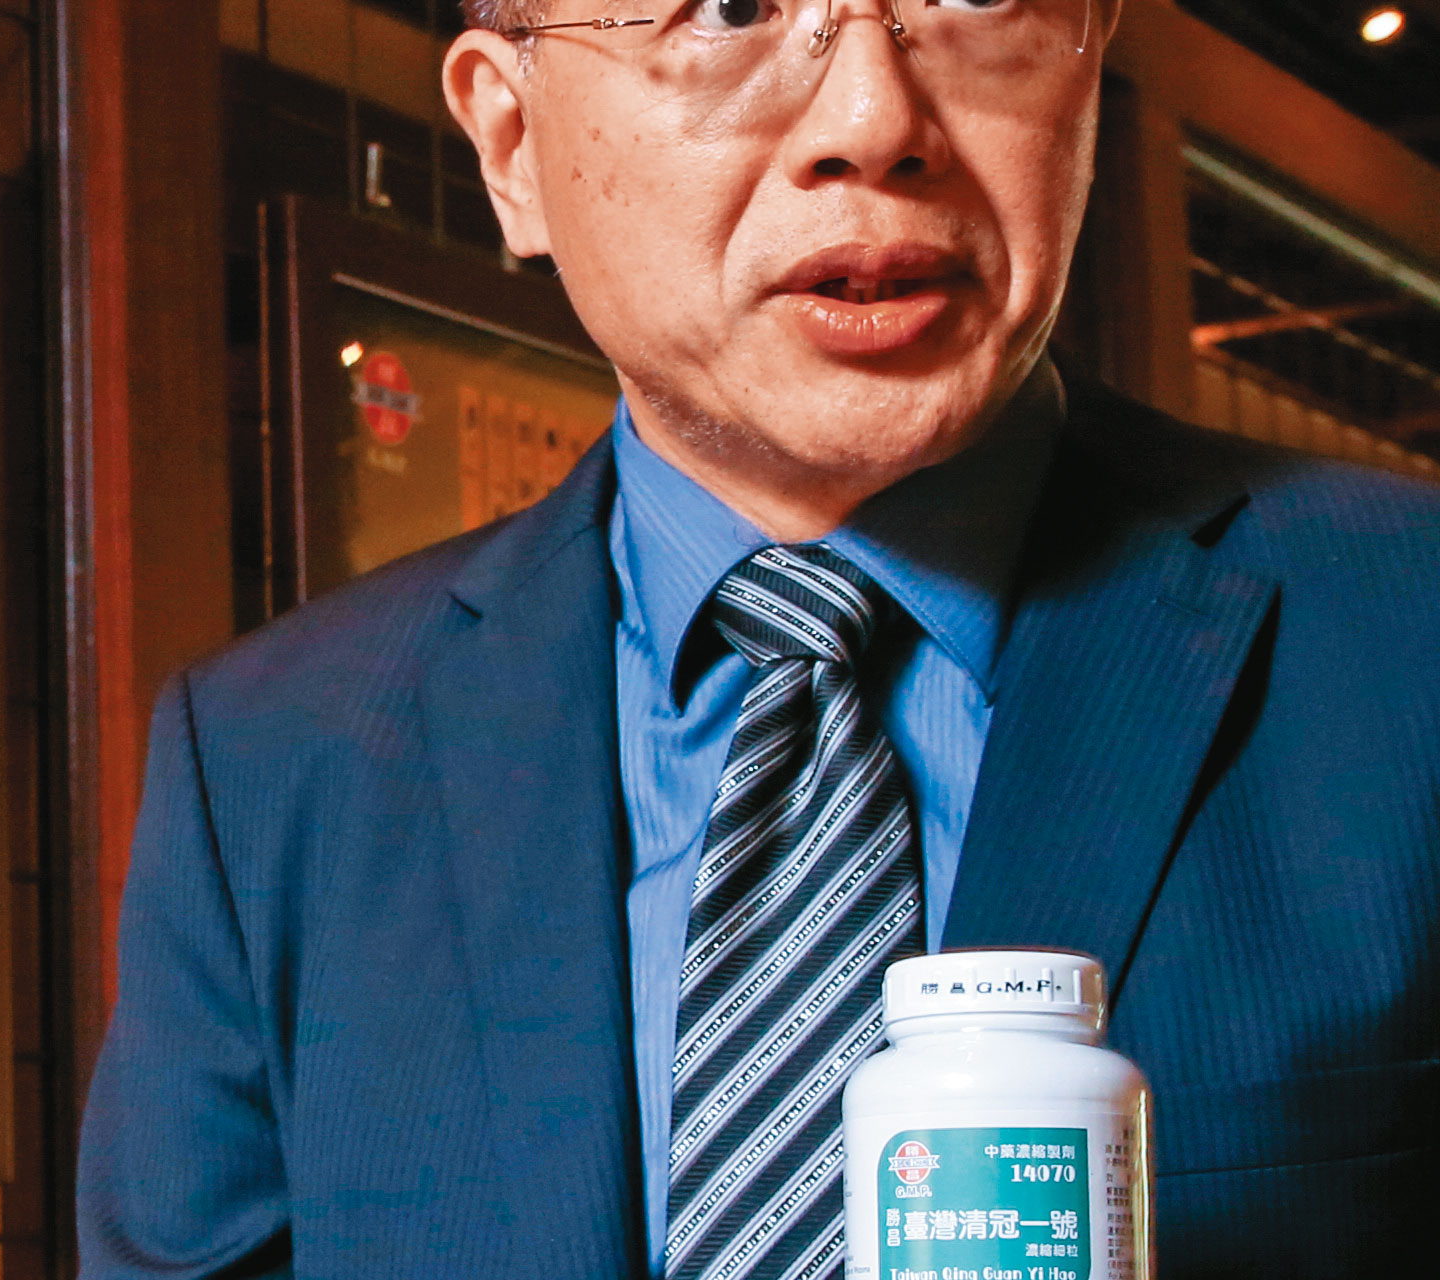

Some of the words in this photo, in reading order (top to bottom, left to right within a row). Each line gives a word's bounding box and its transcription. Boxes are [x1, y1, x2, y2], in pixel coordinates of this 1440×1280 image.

[984, 1143, 1076, 1161] 中藥濃縮製劑
[1010, 1164, 1076, 1183] 14070
[903, 1209, 1079, 1241] 臺灣清冠一號
[1025, 1243, 1079, 1257] 濃縮細粒
[983, 1266, 1022, 1280] Guan
[1027, 1267, 1044, 1280] Yi
[1048, 1267, 1077, 1280] Hao
